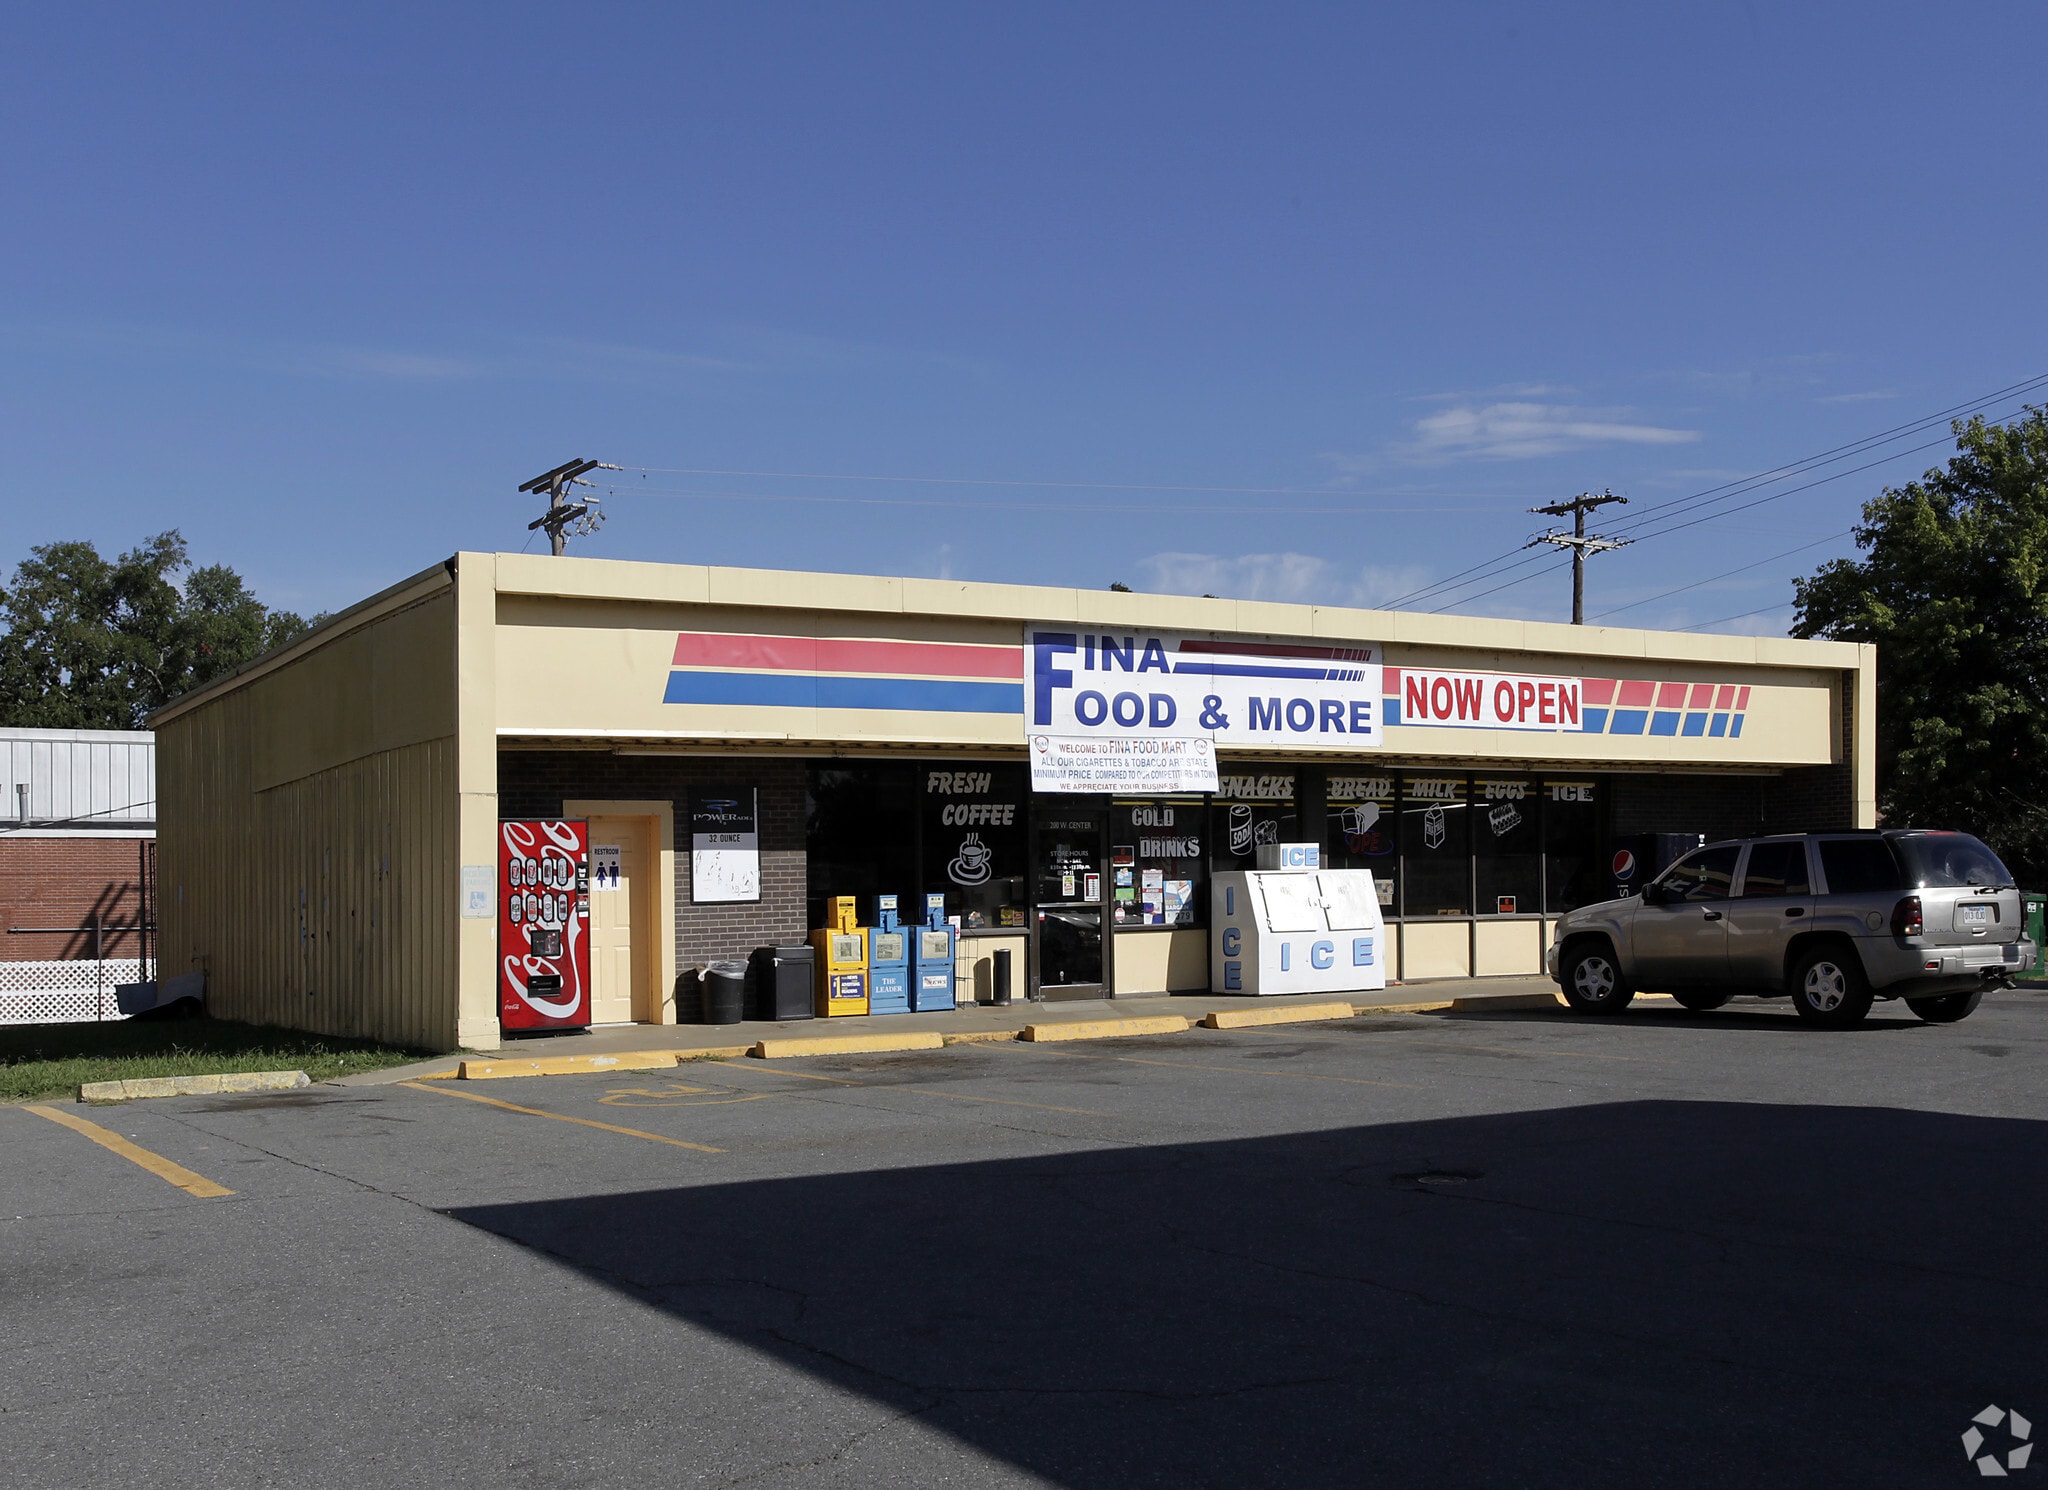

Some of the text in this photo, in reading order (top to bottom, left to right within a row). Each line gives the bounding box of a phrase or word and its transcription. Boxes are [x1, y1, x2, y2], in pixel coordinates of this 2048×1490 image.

[1406, 676, 1578, 725] NOW OPEN
[1199, 694, 1230, 730] &
[1248, 696, 1372, 735] MORE
[1059, 744, 1096, 754] WELCOME
[1098, 744, 1108, 754] TO
[1109, 740, 1131, 754] FINA
[1133, 740, 1159, 754] FOOD
[1161, 741, 1187, 754] MART
[1041, 757, 1055, 767] ALL
[1057, 757, 1074, 767] OUR
[1075, 757, 1123, 767] CIGARETTES
[1124, 758, 1130, 767] &
[1131, 758, 1167, 767] TOBACCO
[1186, 758, 1208, 767] STATE
[927, 772, 991, 795] FRESH
[1034, 769, 1067, 778] MINIMUM
[1068, 769, 1091, 779] PRICE
[1095, 770, 1127, 779] COMPARED
[1128, 770, 1136, 779] TO
[1201, 770, 1216, 779] TOWN
[1219, 776, 1296, 797] SNACKS
[1331, 778, 1391, 797] BREAD
[1412, 778, 1459, 799] MILK
[1485, 780, 1529, 800] EGGS
[1552, 784, 1594, 802] ICE
[942, 804, 1015, 826] COFFEE
[1132, 805, 1174, 826] COLD
[708, 834, 741, 842] 32 OUNCE
[1140, 836, 1200, 857] DRINKS
[594, 848, 619, 856] RESTROOM
[1281, 847, 1320, 867] ICE
[1222, 886, 1243, 990] ICE
[1281, 937, 1375, 972] ICE
[875, 985, 903, 993] LEADER
[882, 977, 896, 985] THE
